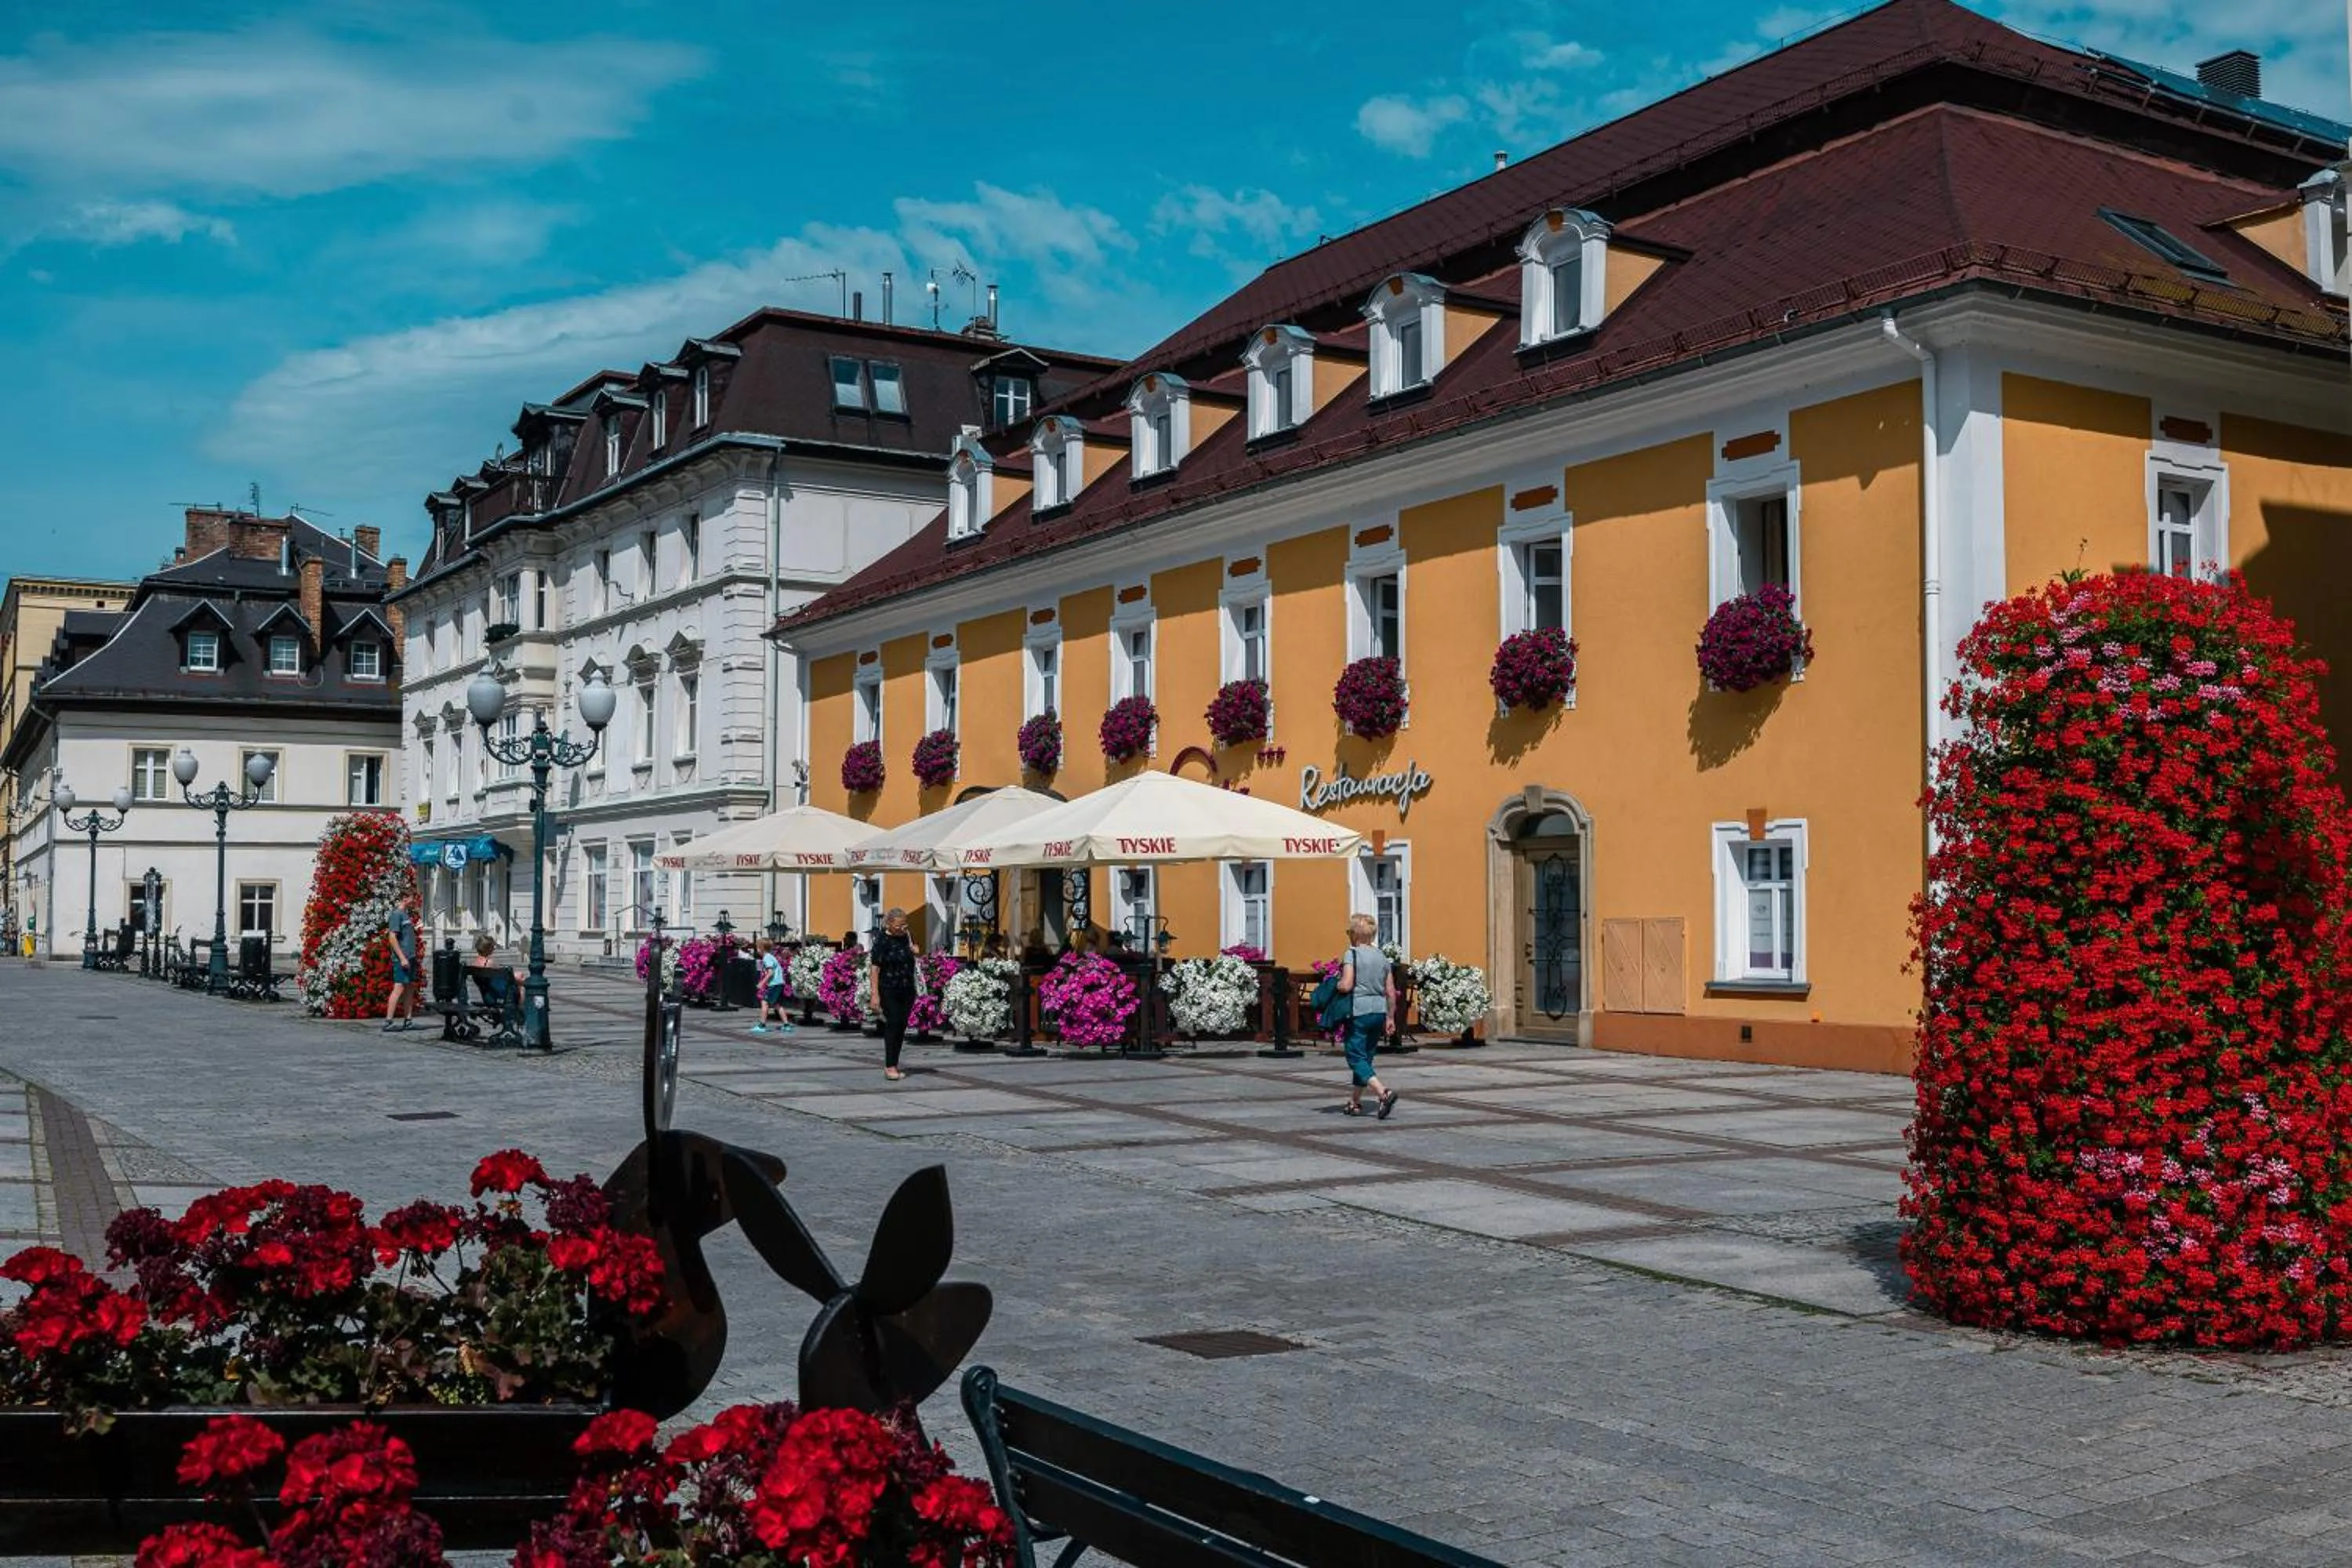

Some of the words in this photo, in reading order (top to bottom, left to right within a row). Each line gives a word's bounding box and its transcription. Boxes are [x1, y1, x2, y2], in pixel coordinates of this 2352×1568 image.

[1300, 758, 1431, 814] Restauracja
[1043, 840, 1073, 857] TYSKIE
[1116, 837, 1177, 854] TYSKIE
[1282, 838, 1337, 853] TYSKIE
[796, 854, 833, 865] TYSKIE
